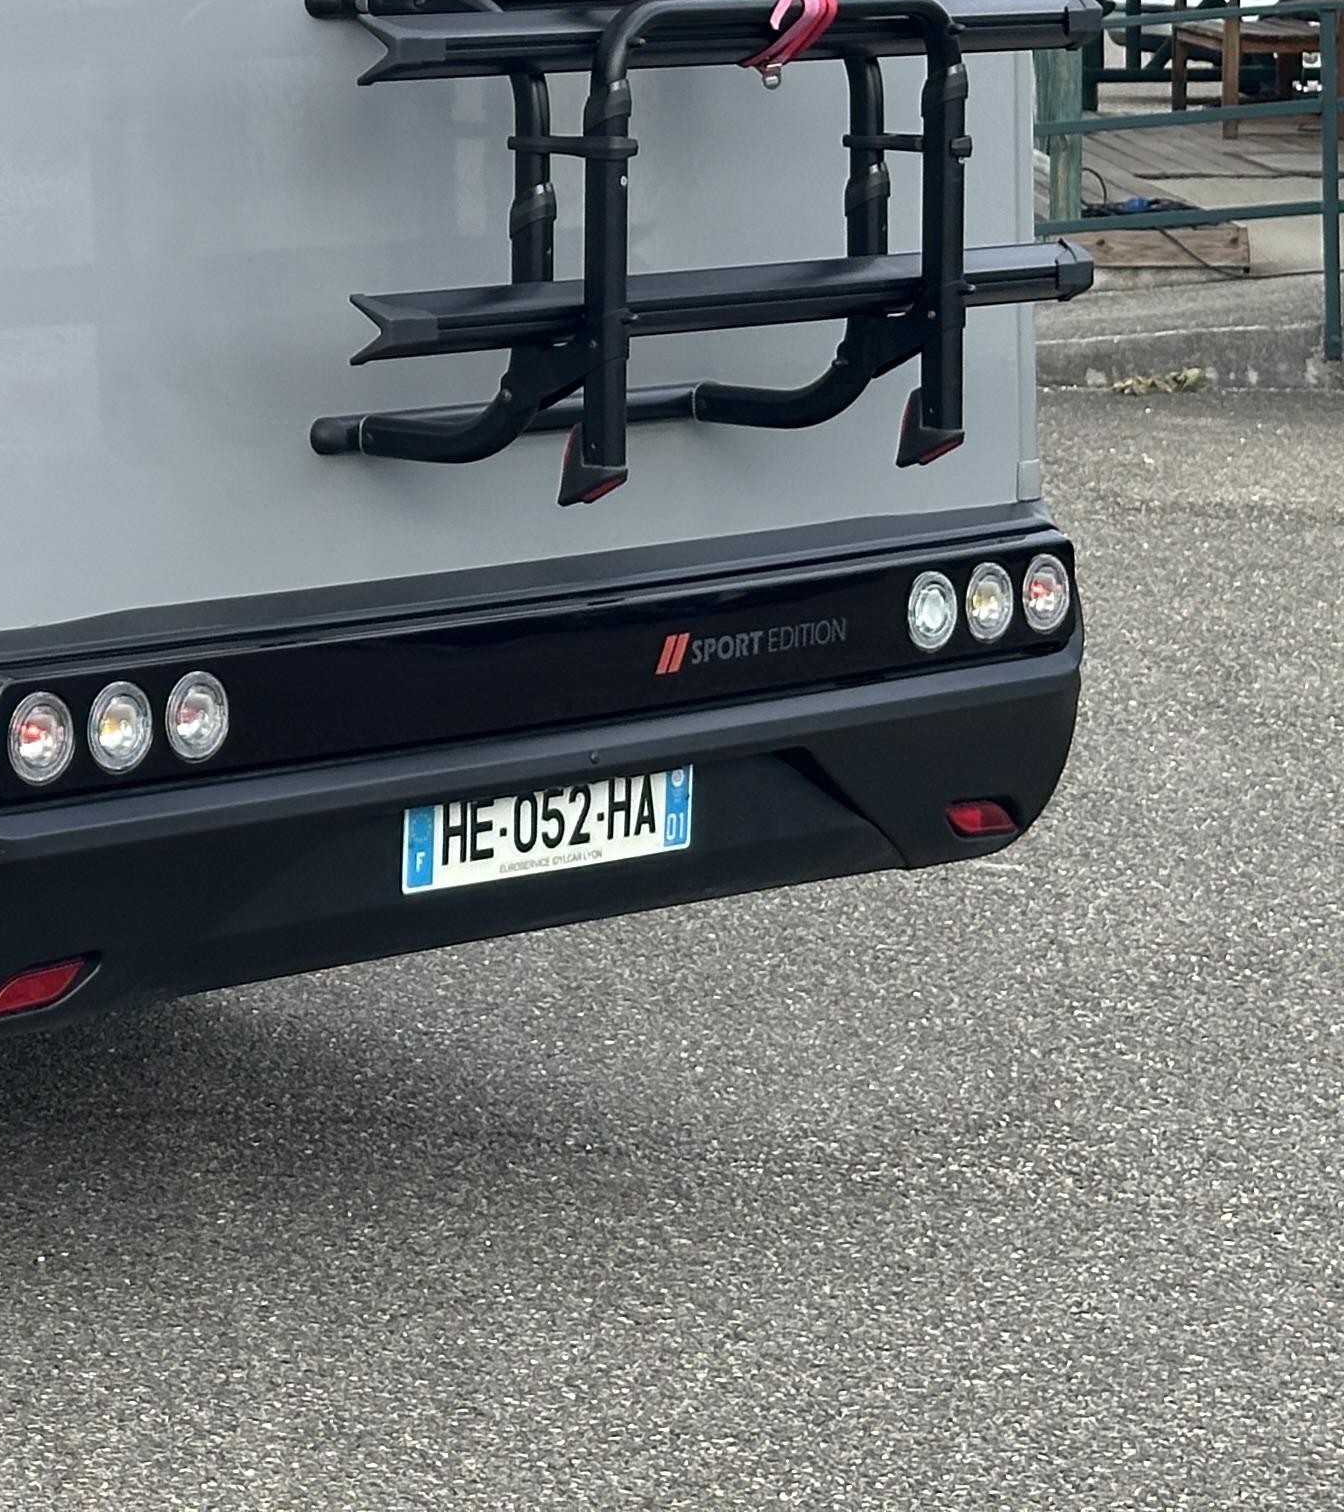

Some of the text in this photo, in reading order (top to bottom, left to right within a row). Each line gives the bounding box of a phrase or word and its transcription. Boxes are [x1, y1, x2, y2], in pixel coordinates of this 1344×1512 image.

[691, 617, 847, 665] SPORT EDITION
[666, 812, 685, 841] 01
[416, 851, 426, 873] F
